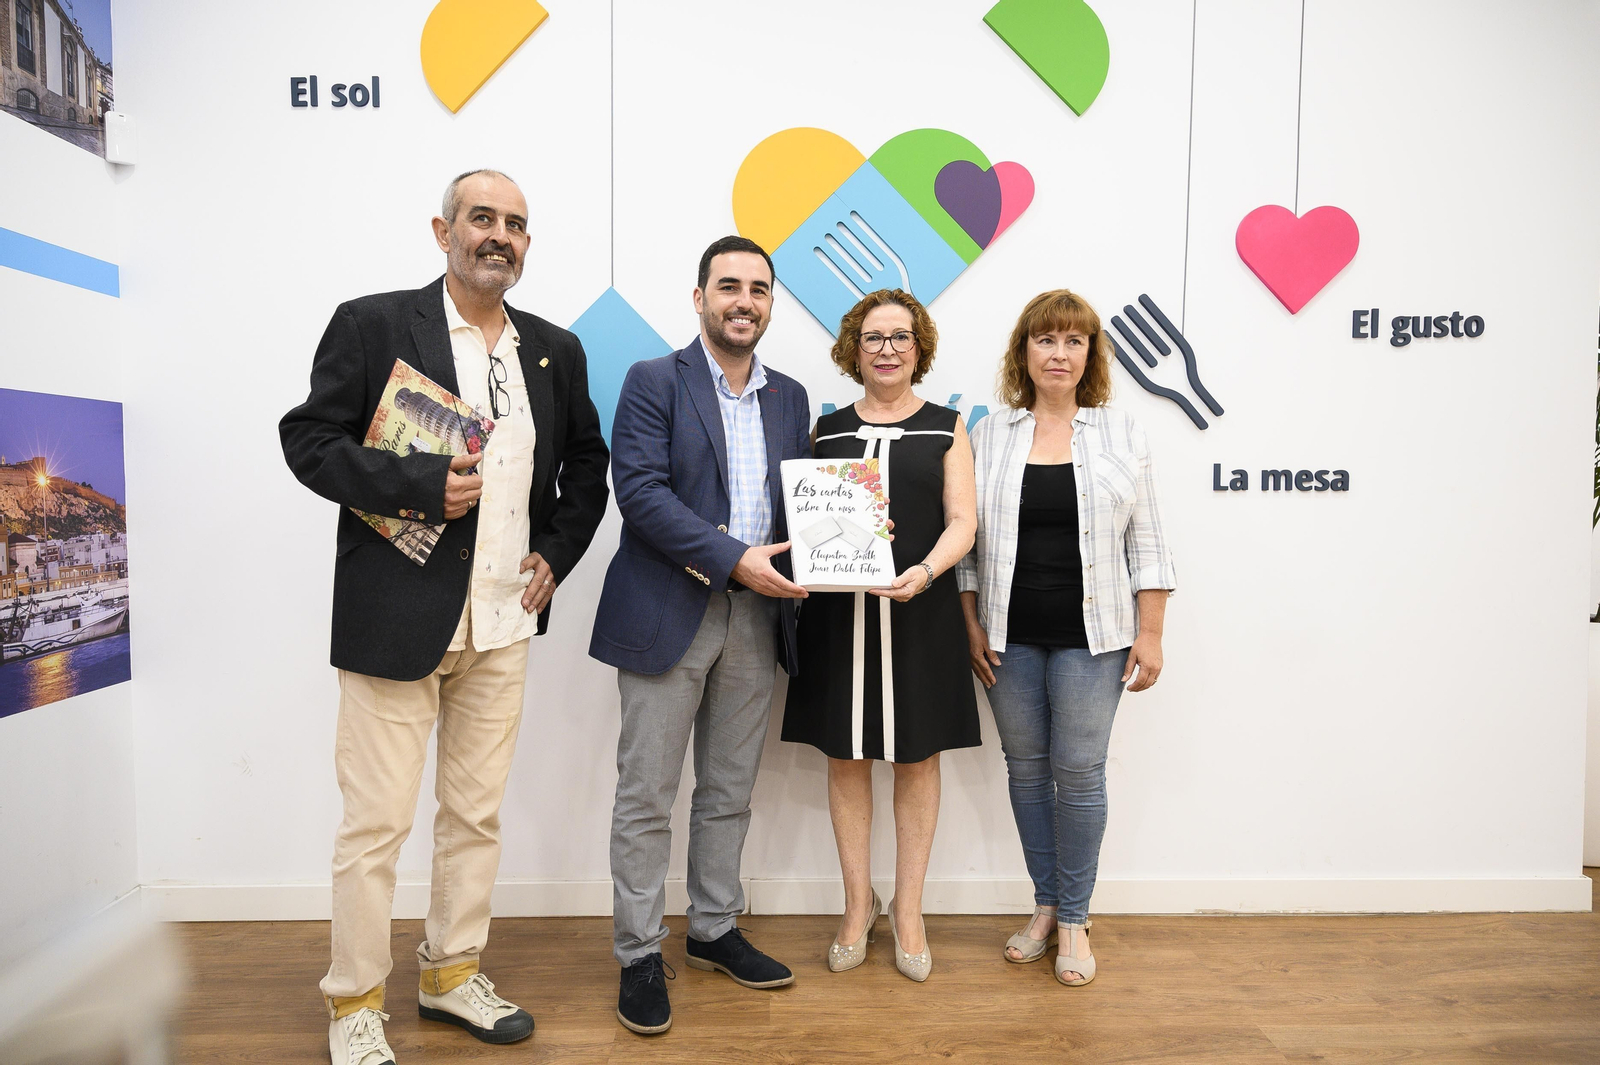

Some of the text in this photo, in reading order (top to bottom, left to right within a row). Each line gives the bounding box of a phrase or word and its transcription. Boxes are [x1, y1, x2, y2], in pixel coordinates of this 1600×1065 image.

[290, 75, 380, 108] El sol
[1352, 308, 1485, 347] El gusto
[379, 420, 406, 451] Paris
[792, 477, 853, 499] Las cartas
[1213, 463, 1350, 491] La mesa
[796, 500, 856, 513] sobre la mesa
[809, 562, 829, 573] Juan
[833, 563, 855, 573] Pablo
[810, 549, 876, 561] Cleopatra Smith
